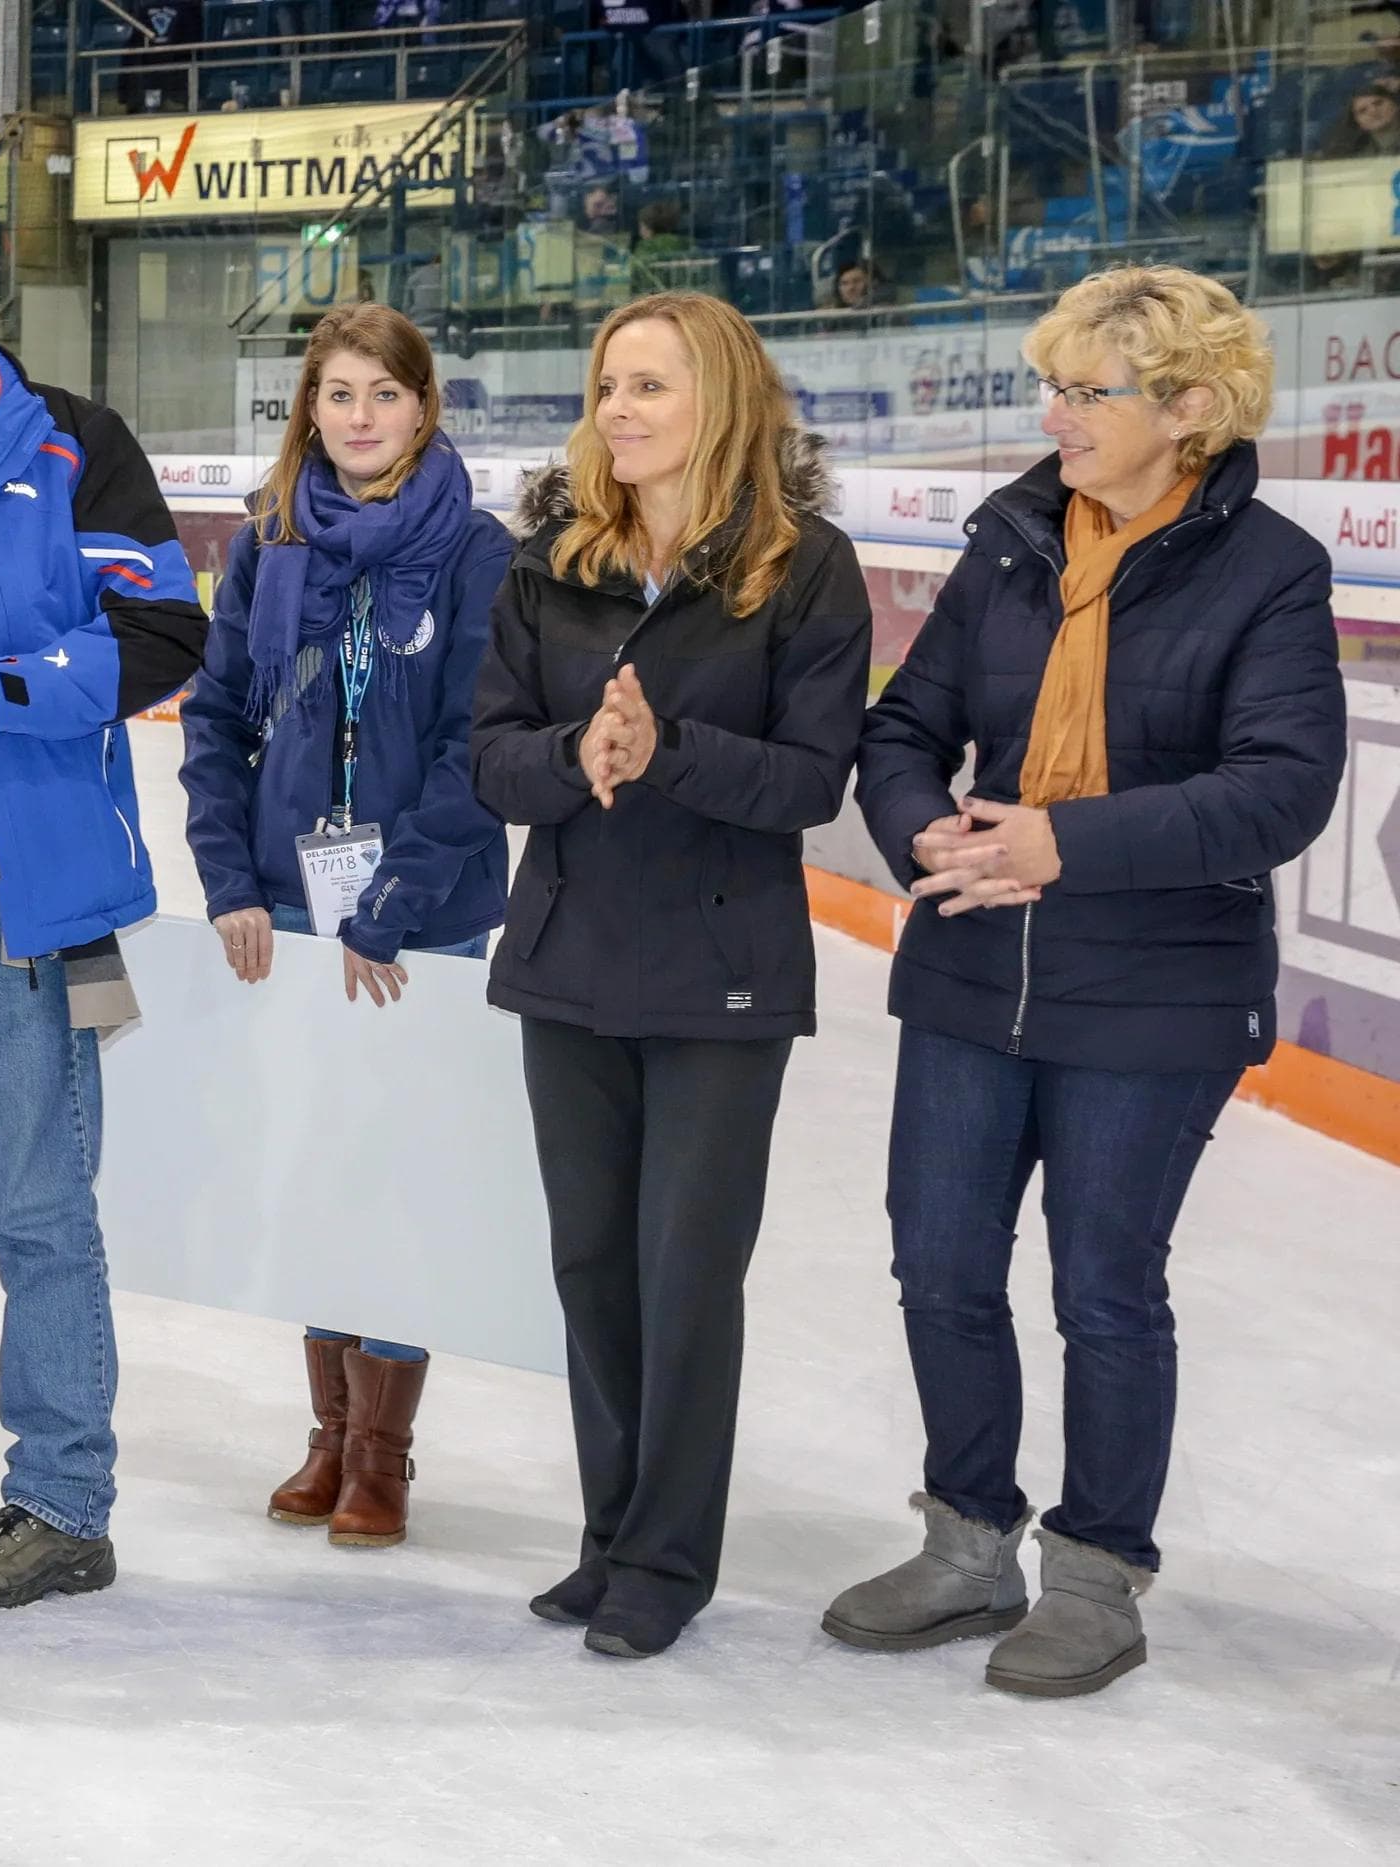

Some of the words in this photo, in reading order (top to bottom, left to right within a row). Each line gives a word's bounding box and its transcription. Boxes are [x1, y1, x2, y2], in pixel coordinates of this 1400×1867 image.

[160, 466, 196, 483] Audi
[890, 487, 924, 518] Audi
[1337, 507, 1397, 549] Audi
[309, 855, 357, 875] 17/18
